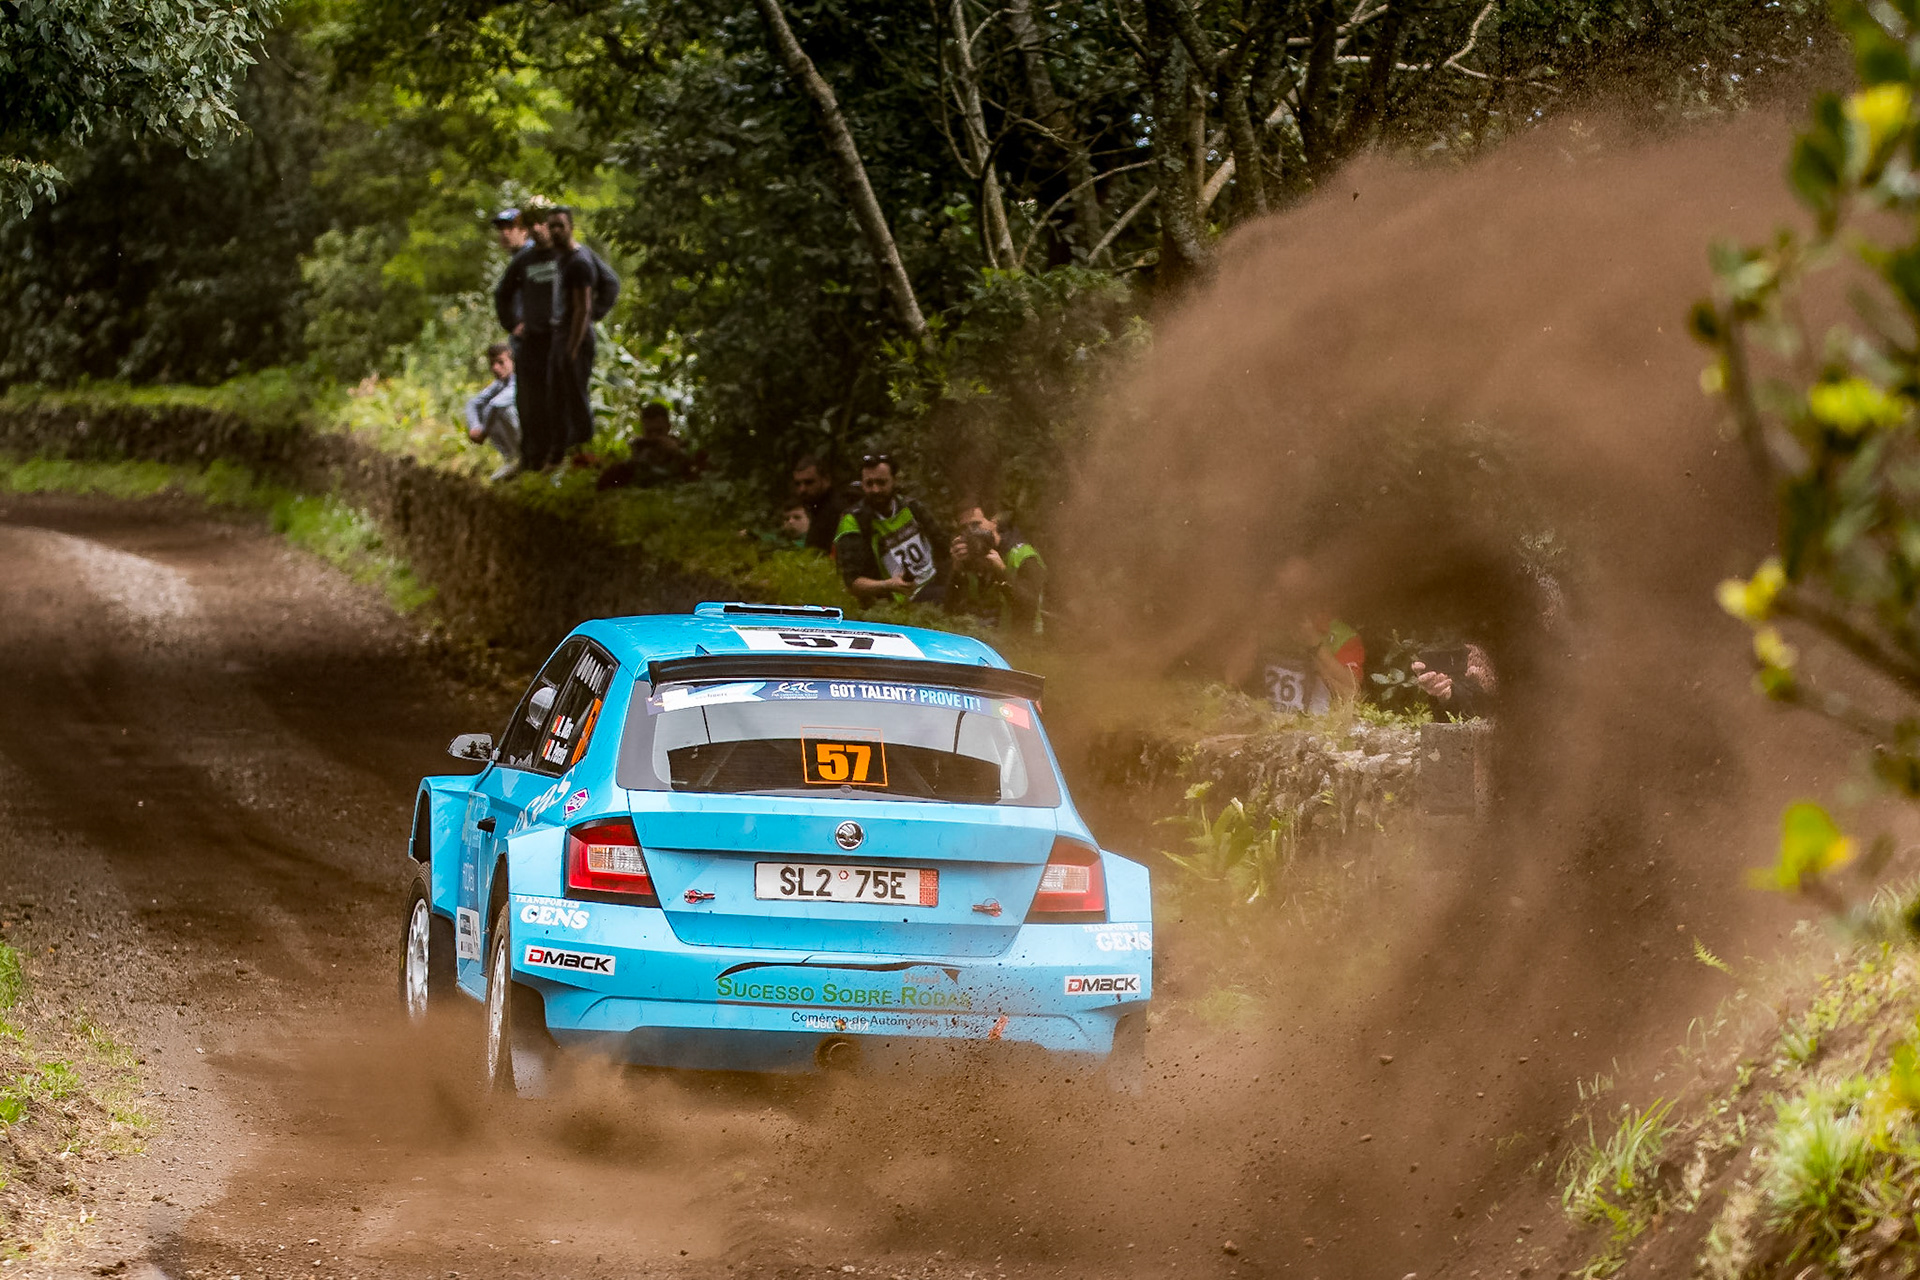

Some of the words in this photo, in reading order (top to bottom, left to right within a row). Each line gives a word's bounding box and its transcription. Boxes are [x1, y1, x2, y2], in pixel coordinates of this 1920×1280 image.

[778, 633, 875, 650] 57
[829, 684, 856, 698] GOT
[858, 684, 917, 702] TALENT?
[919, 689, 962, 707] PROVE
[816, 743, 871, 782] 57
[855, 869, 906, 899] 75E
[520, 904, 590, 930] GENS
[1096, 931, 1152, 952] GENS
